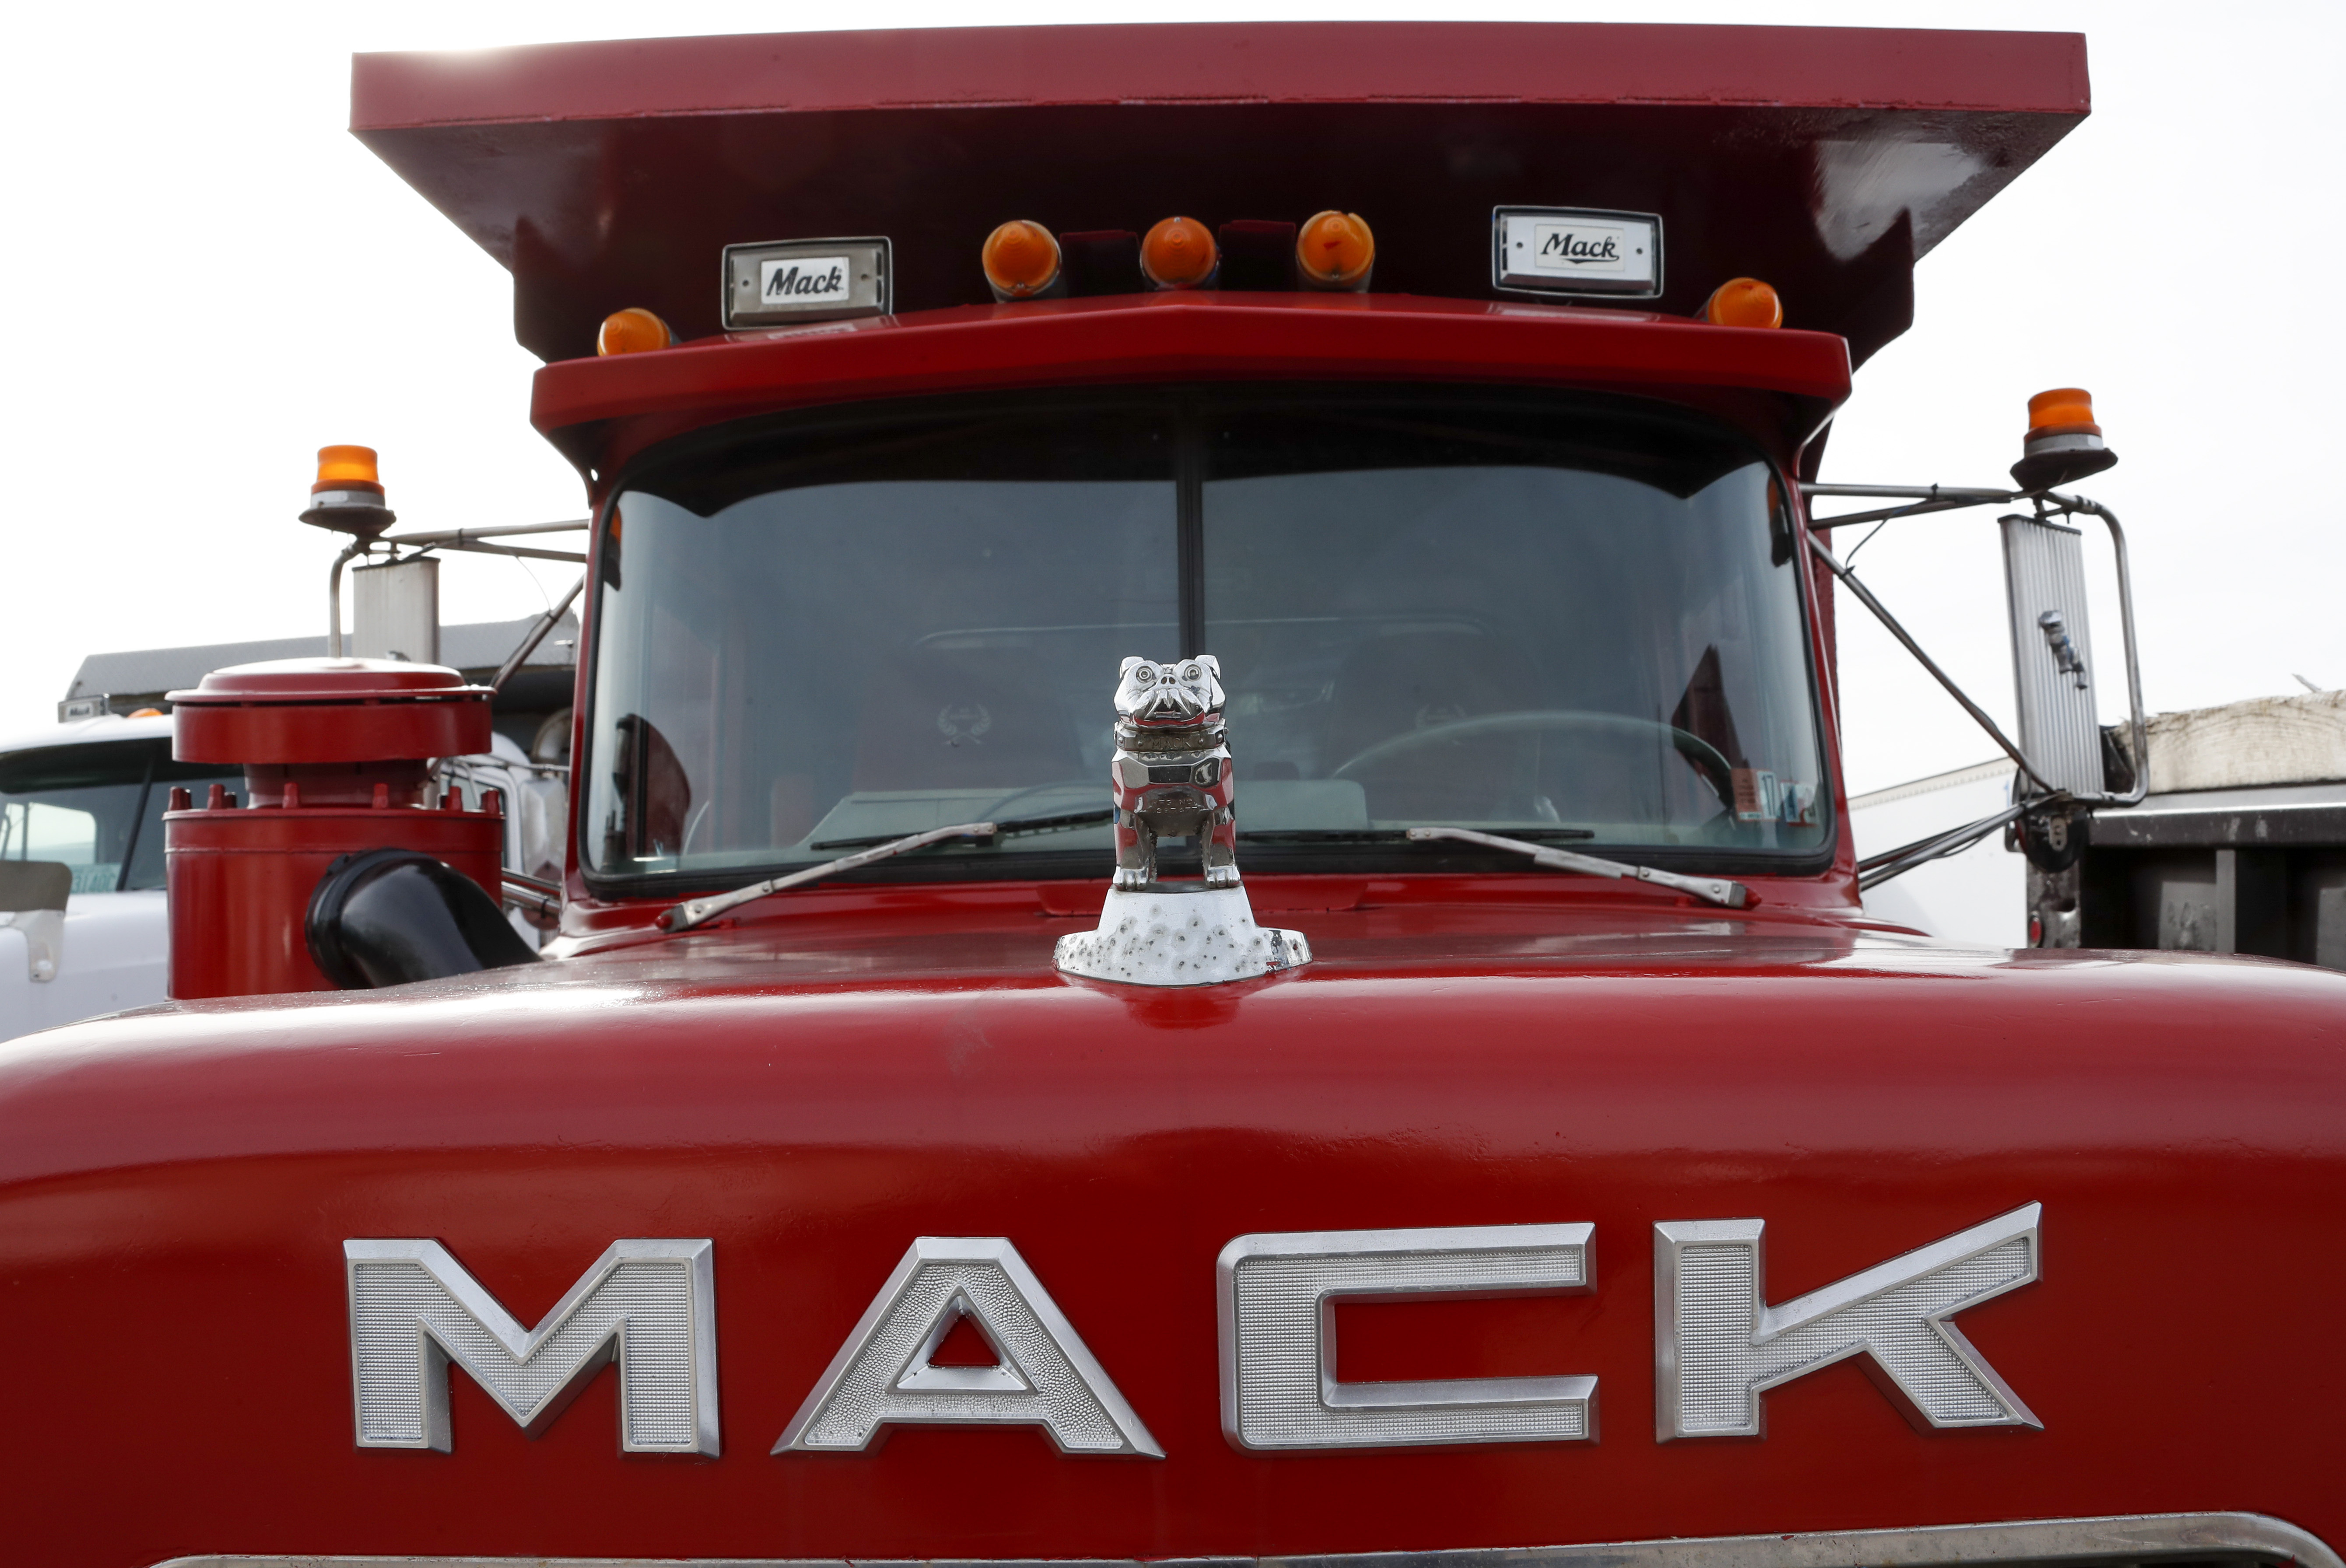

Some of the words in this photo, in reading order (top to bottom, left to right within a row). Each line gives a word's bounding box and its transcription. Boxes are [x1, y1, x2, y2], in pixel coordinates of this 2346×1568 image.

[1540, 233, 1620, 263] Mack
[767, 266, 842, 296] Mack
[1151, 737, 1191, 750] MACK
[343, 1201, 2044, 1458] MACK
